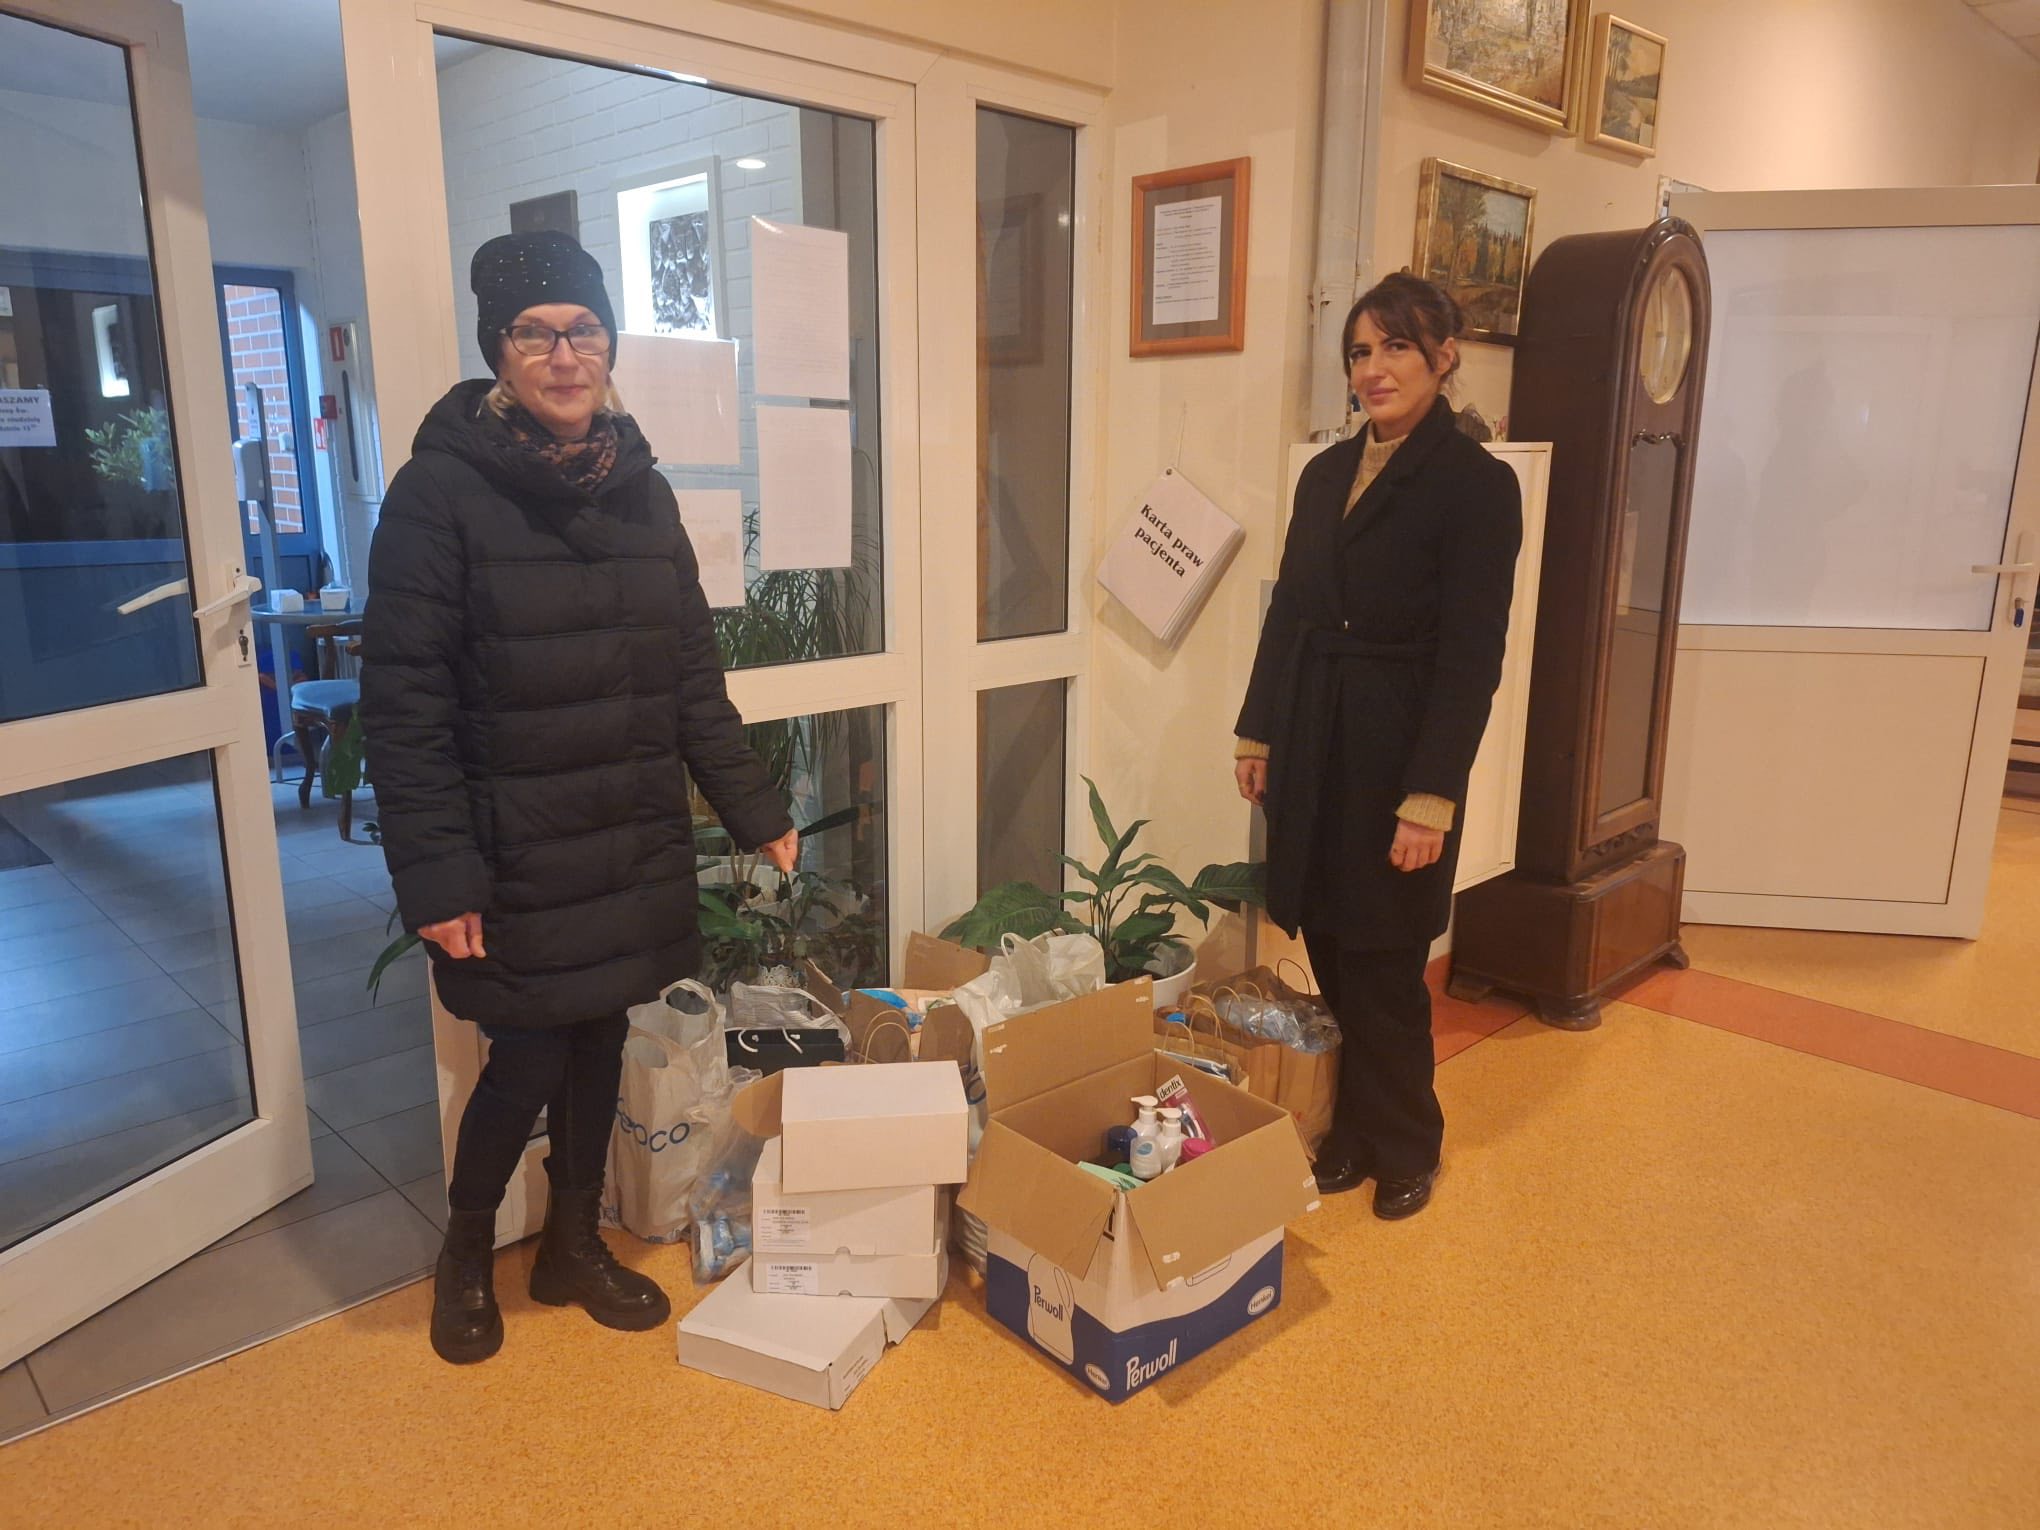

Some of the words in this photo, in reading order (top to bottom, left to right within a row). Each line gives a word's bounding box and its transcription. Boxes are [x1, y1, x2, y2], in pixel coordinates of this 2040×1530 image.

[1134, 527, 1186, 578] pacjenta
[1140, 504, 1174, 540] Karta
[1171, 538, 1205, 568] praw
[1160, 1079, 1182, 1098] dentix
[1034, 1284, 1064, 1322] Perwoll
[1126, 1337, 1178, 1391] Perwoll
